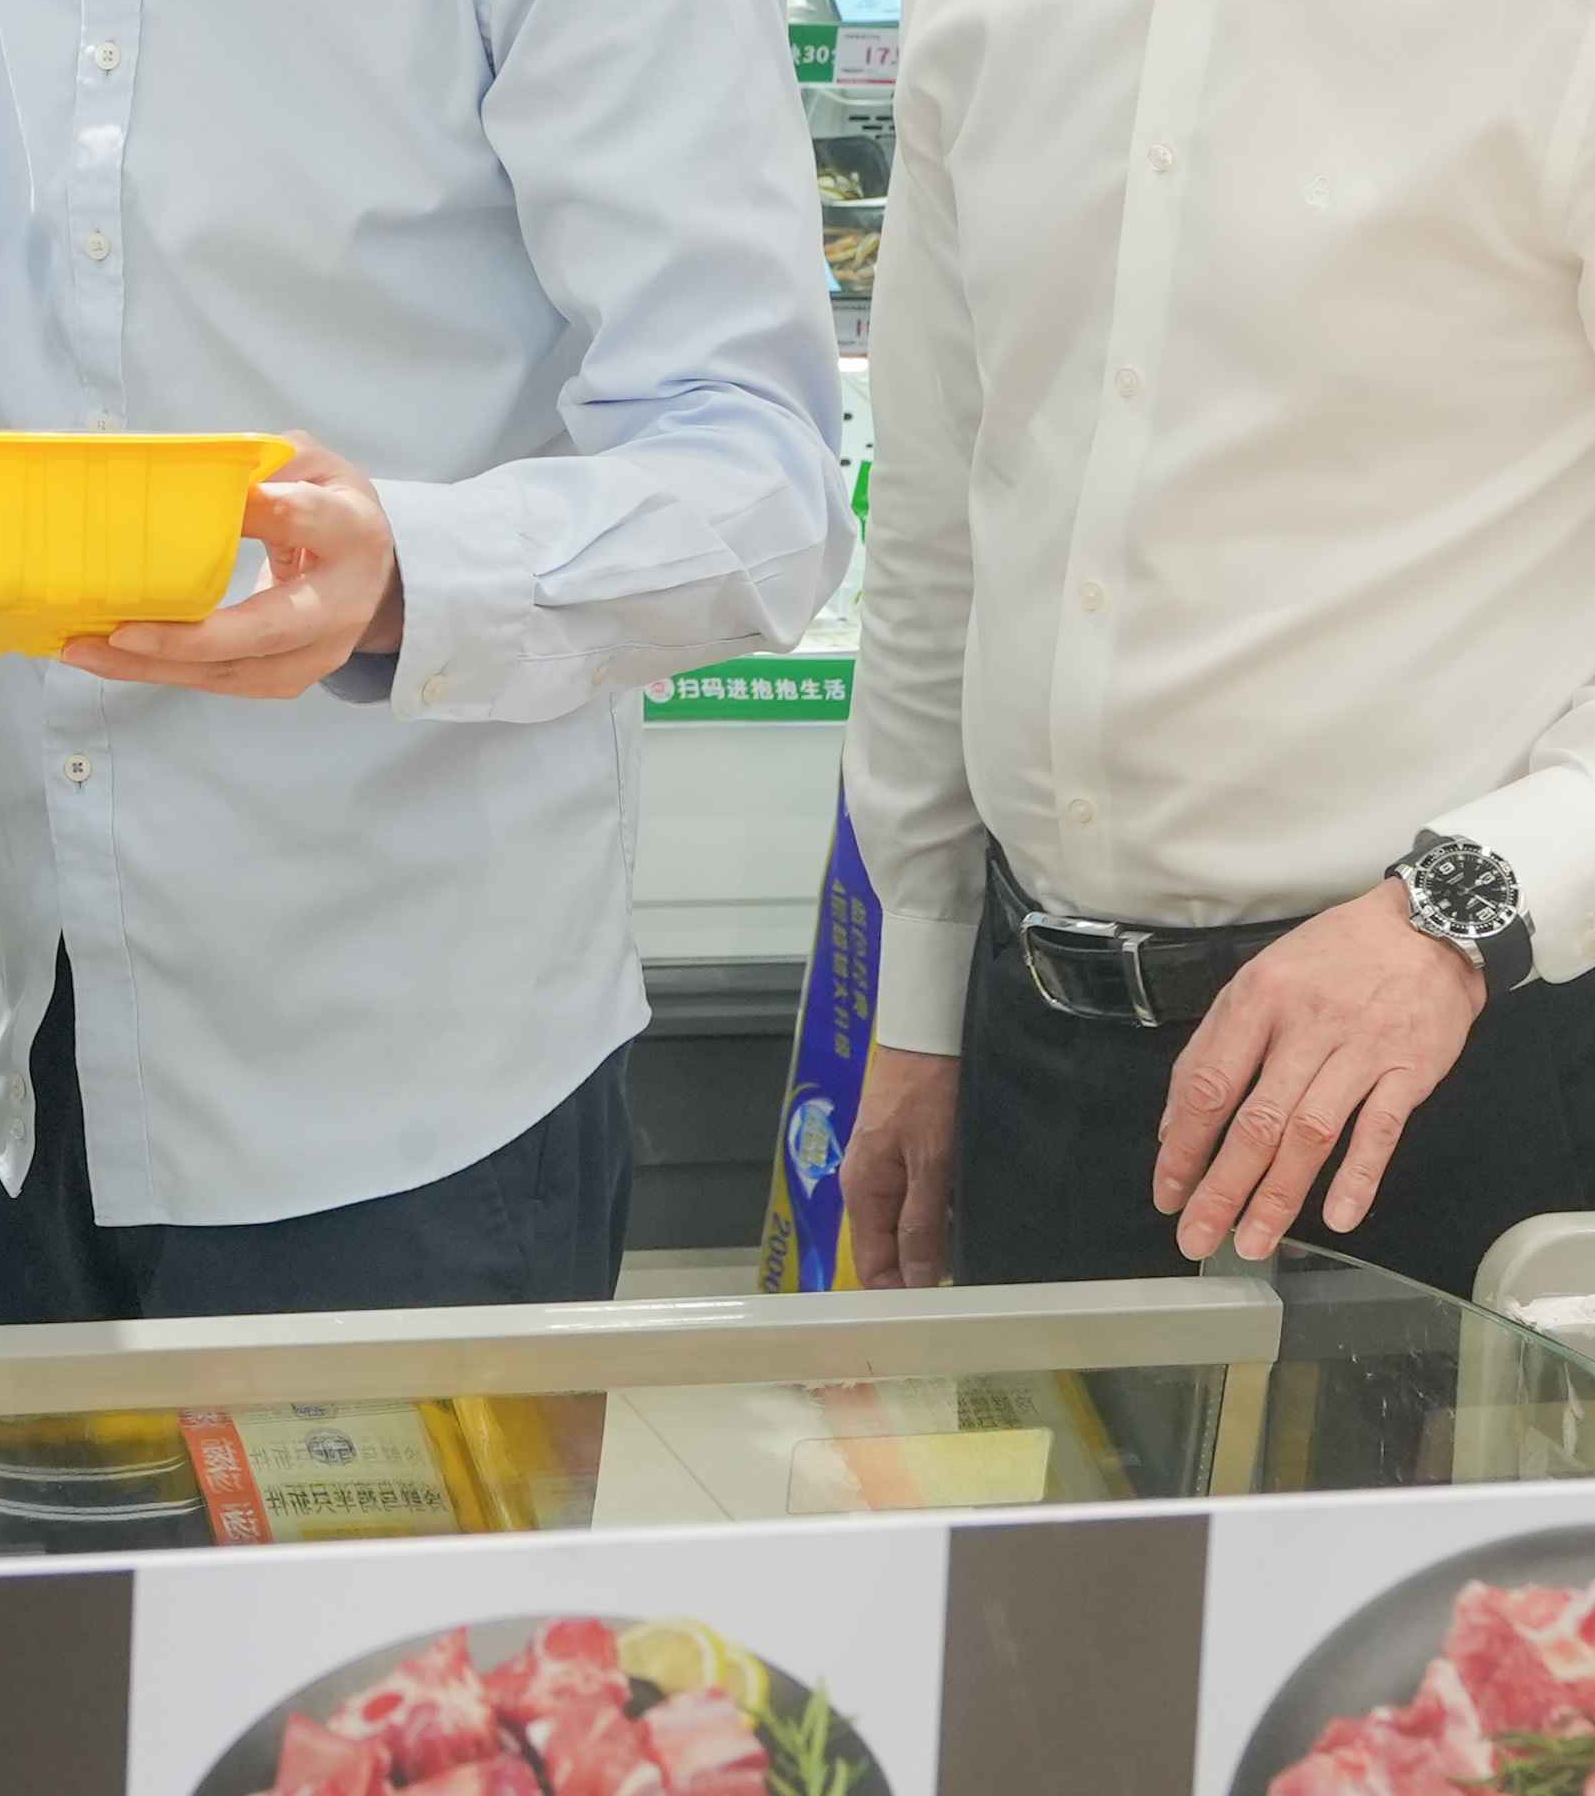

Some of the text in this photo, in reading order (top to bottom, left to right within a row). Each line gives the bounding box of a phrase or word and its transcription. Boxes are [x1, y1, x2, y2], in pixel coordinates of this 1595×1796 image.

[677, 678, 846, 701] 扫码进抱抱生活
